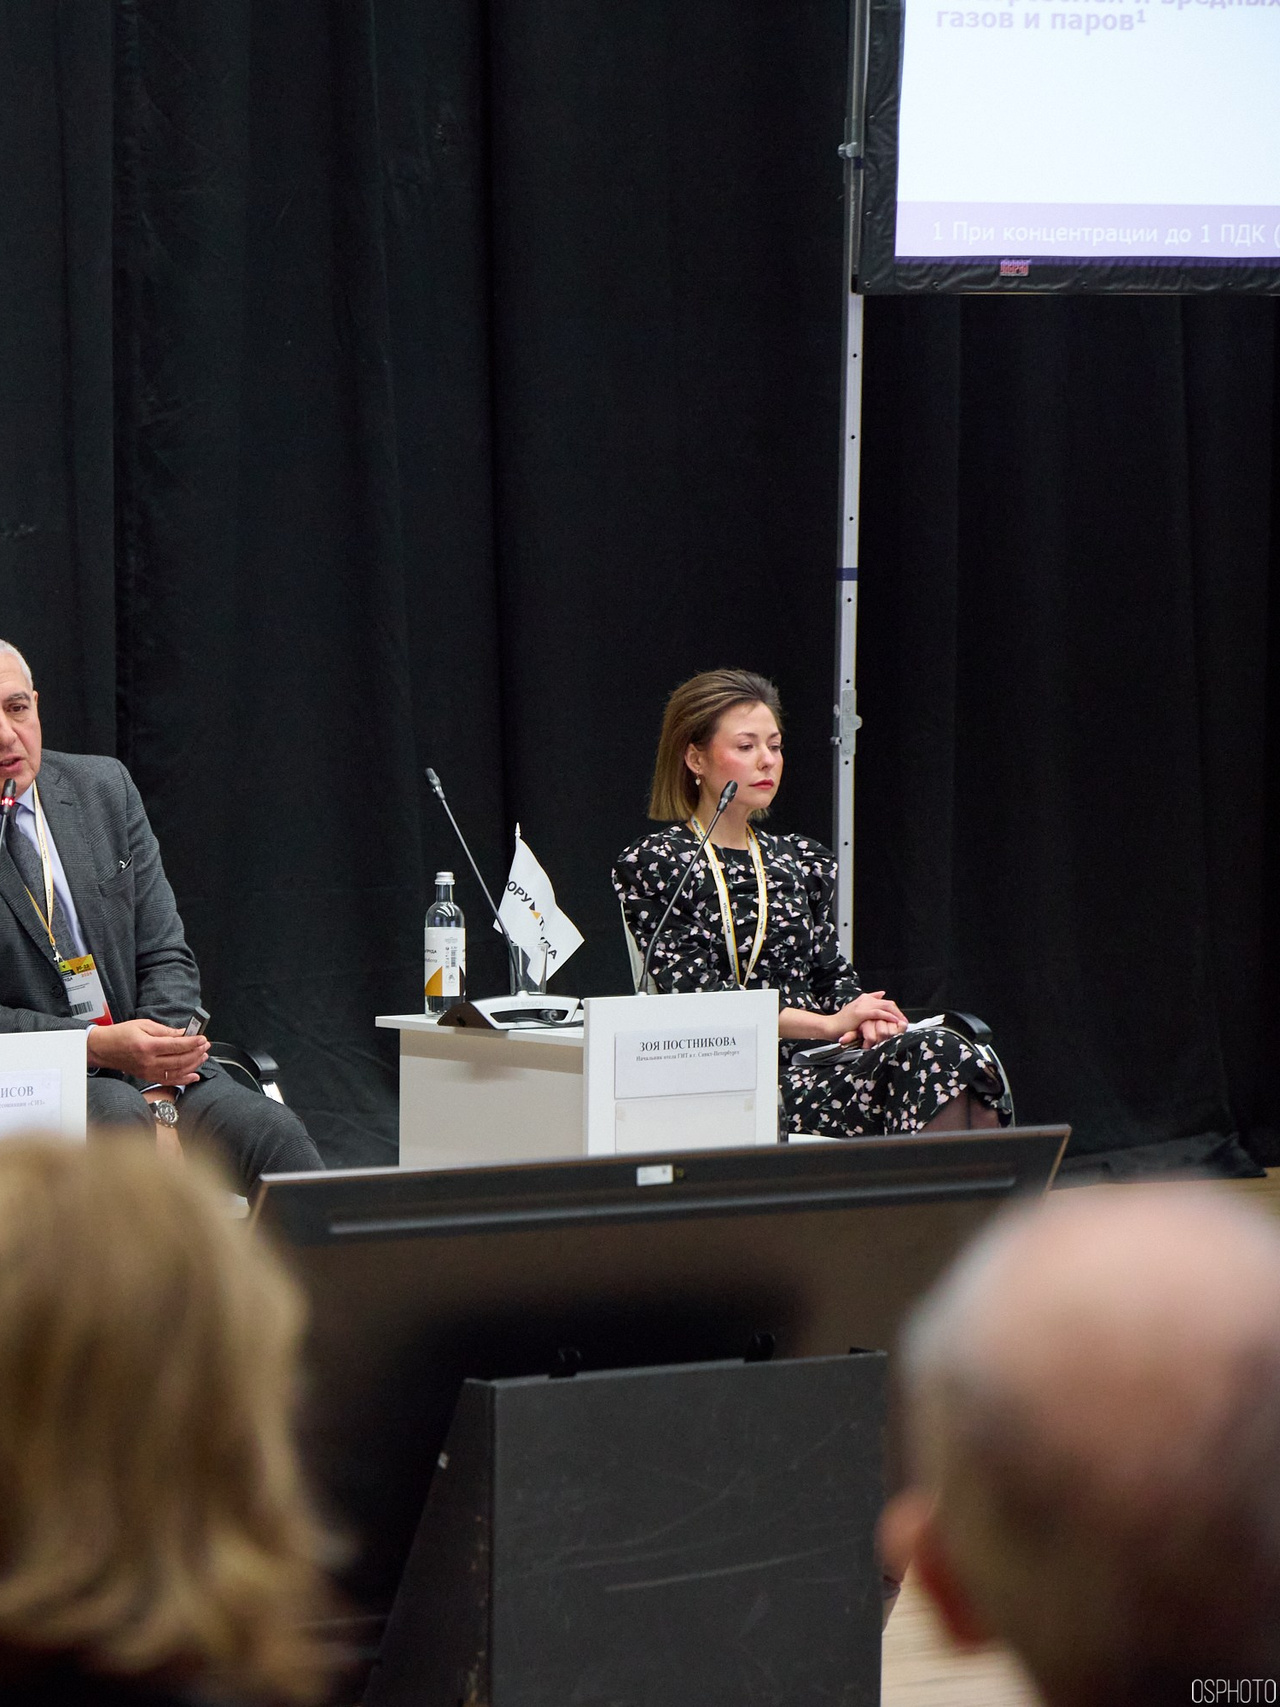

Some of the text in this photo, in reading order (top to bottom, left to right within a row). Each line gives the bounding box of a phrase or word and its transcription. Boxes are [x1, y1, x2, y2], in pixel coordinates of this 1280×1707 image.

[936, 10, 1014, 28] газов
[1024, 12, 1040, 29] и
[933, 221, 944, 241] 1
[953, 221, 995, 245] При
[1003, 225, 1158, 247] концентрации
[1164, 228, 1193, 246] до
[1200, 224, 1211, 243] 1
[1220, 224, 1266, 247] ПДК
[640, 1036, 737, 1052] ЗОЯ ПОСТНИКОВА
